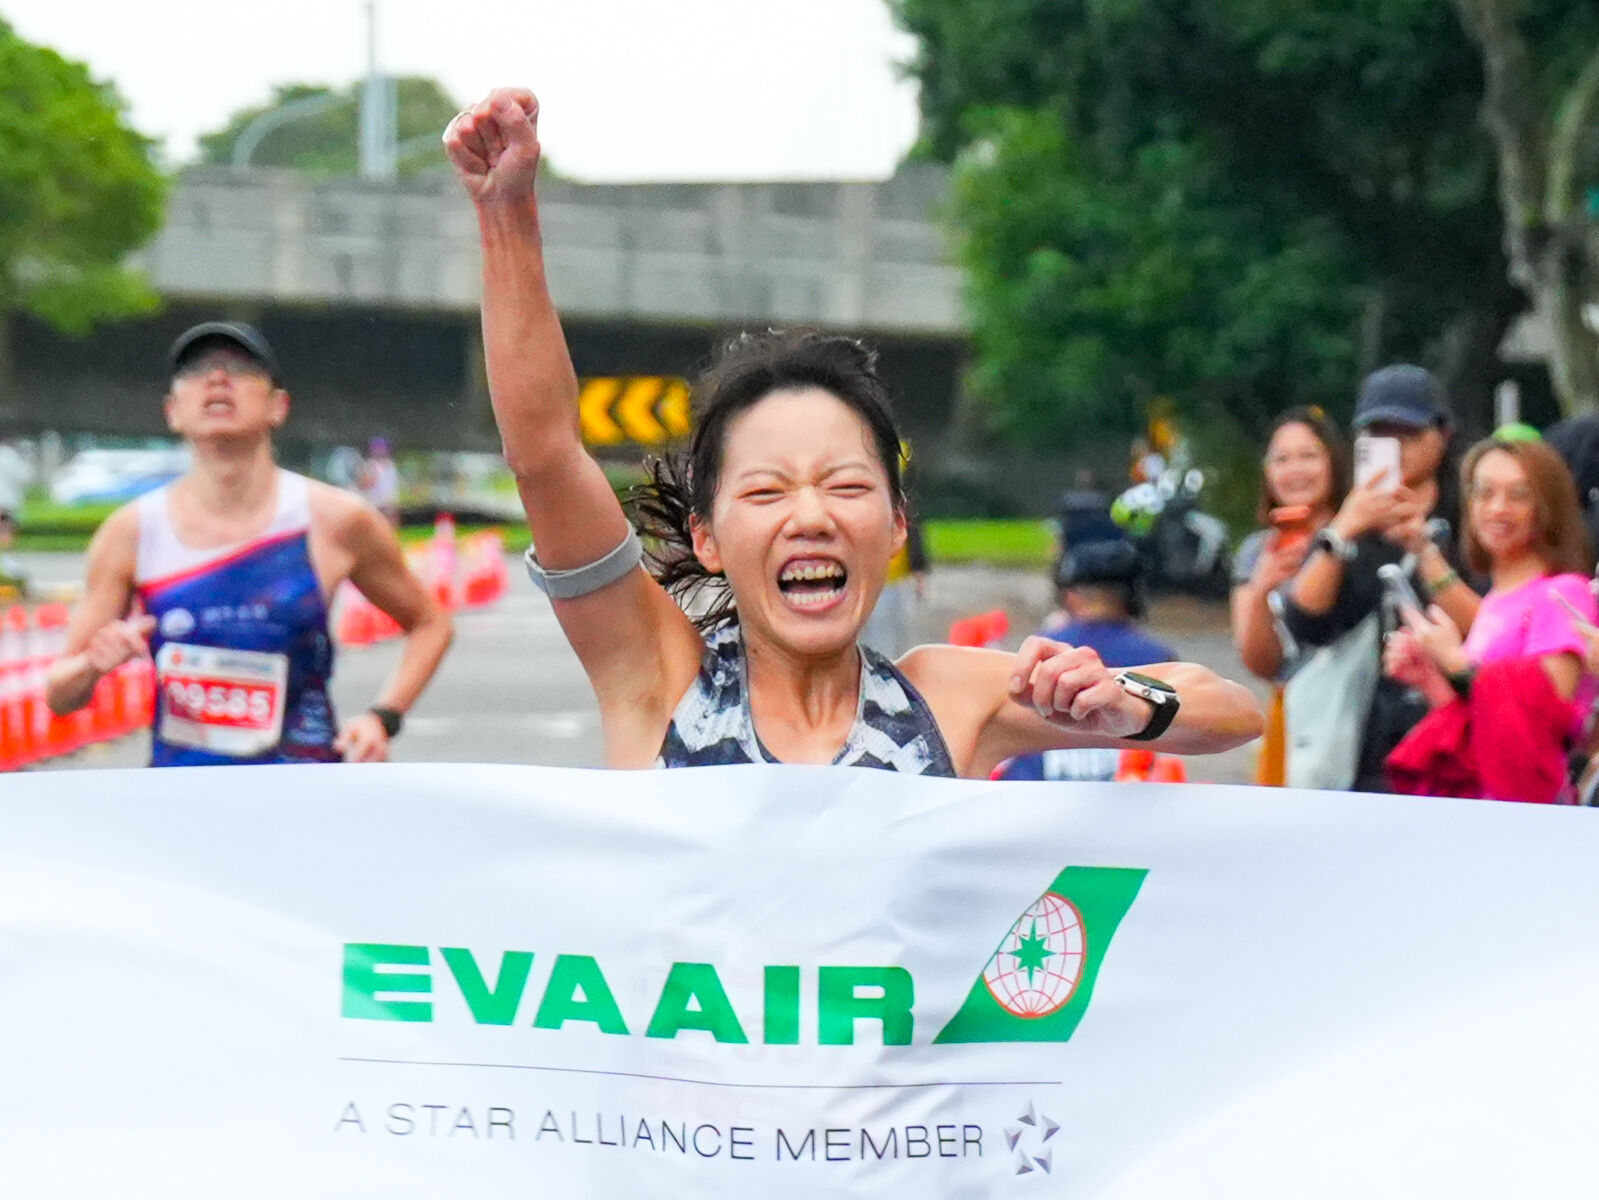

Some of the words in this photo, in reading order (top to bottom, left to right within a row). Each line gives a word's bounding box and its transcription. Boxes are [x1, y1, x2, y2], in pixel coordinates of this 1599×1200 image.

[335, 1101, 367, 1133] A
[386, 1102, 516, 1142] STAR
[534, 1109, 756, 1162] ALLIANCE
[774, 1124, 985, 1162] MEMBER
